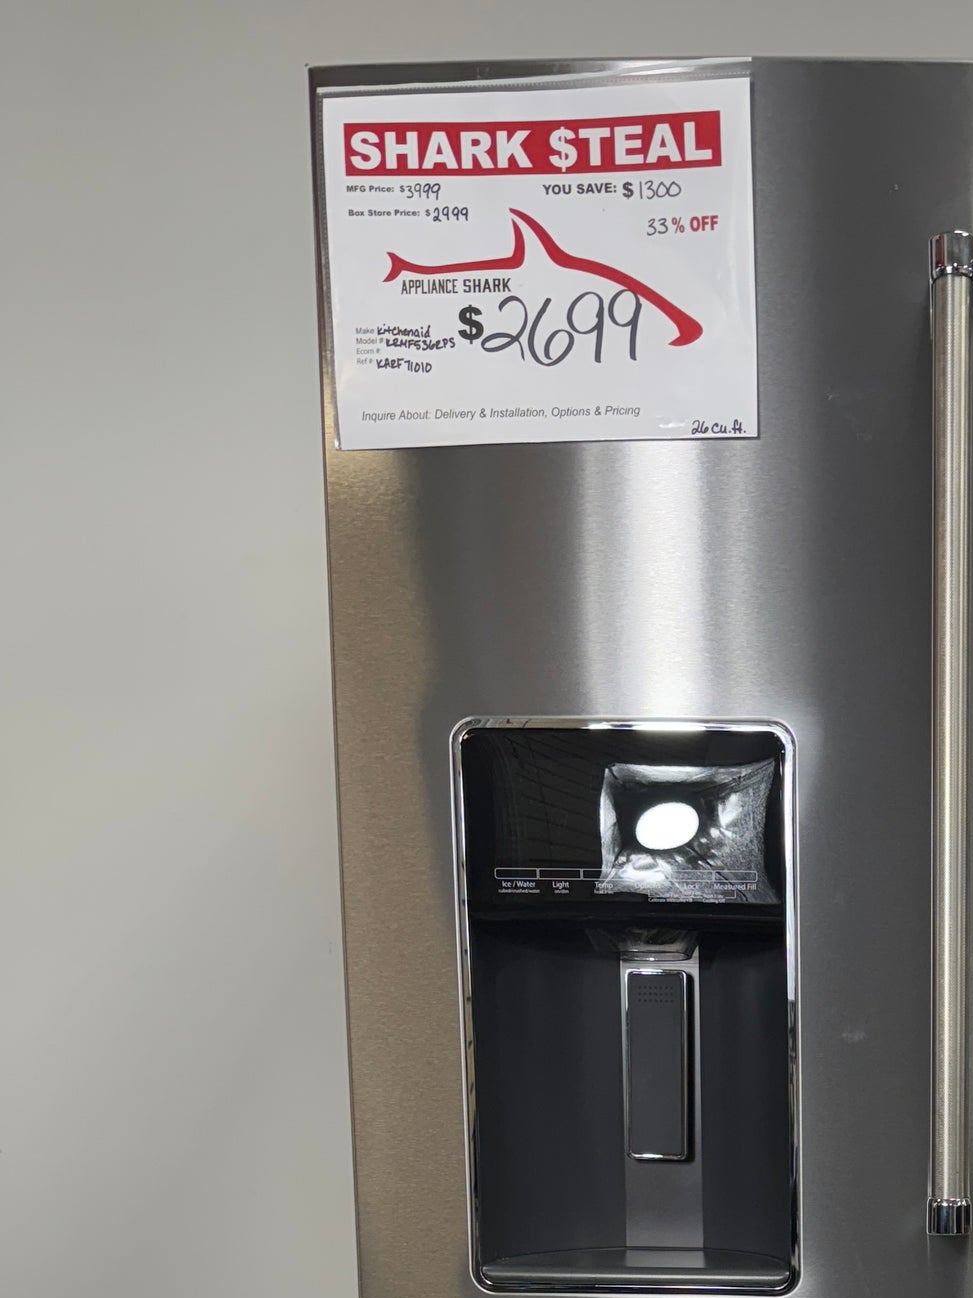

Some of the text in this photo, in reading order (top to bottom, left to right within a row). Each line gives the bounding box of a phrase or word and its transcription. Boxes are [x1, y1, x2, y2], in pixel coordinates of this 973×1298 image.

[350, 121, 713, 172] SHARK $TEAL
[346, 185, 366, 193] MFG
[368, 185, 395, 193] Price:
[543, 183, 572, 195] YOU
[576, 182, 617, 195] SAVE:
[348, 209, 365, 217] Box
[367, 209, 391, 217] Store
[394, 209, 420, 217] Price:
[689, 215, 719, 232] OFF
[401, 278, 511, 295] APPLIANCE SHARK
[356, 337, 377, 345] Model
[362, 411, 396, 423] Inquire
[434, 408, 476, 421] Delivery
[479, 407, 487, 418] &
[490, 406, 547, 419] Installation,
[551, 406, 591, 418] Options
[594, 406, 601, 416] &
[604, 405, 641, 417] Pricing
[552, 881, 570, 889] Light
[683, 882, 699, 890] Lock
[714, 883, 744, 891] Measured
